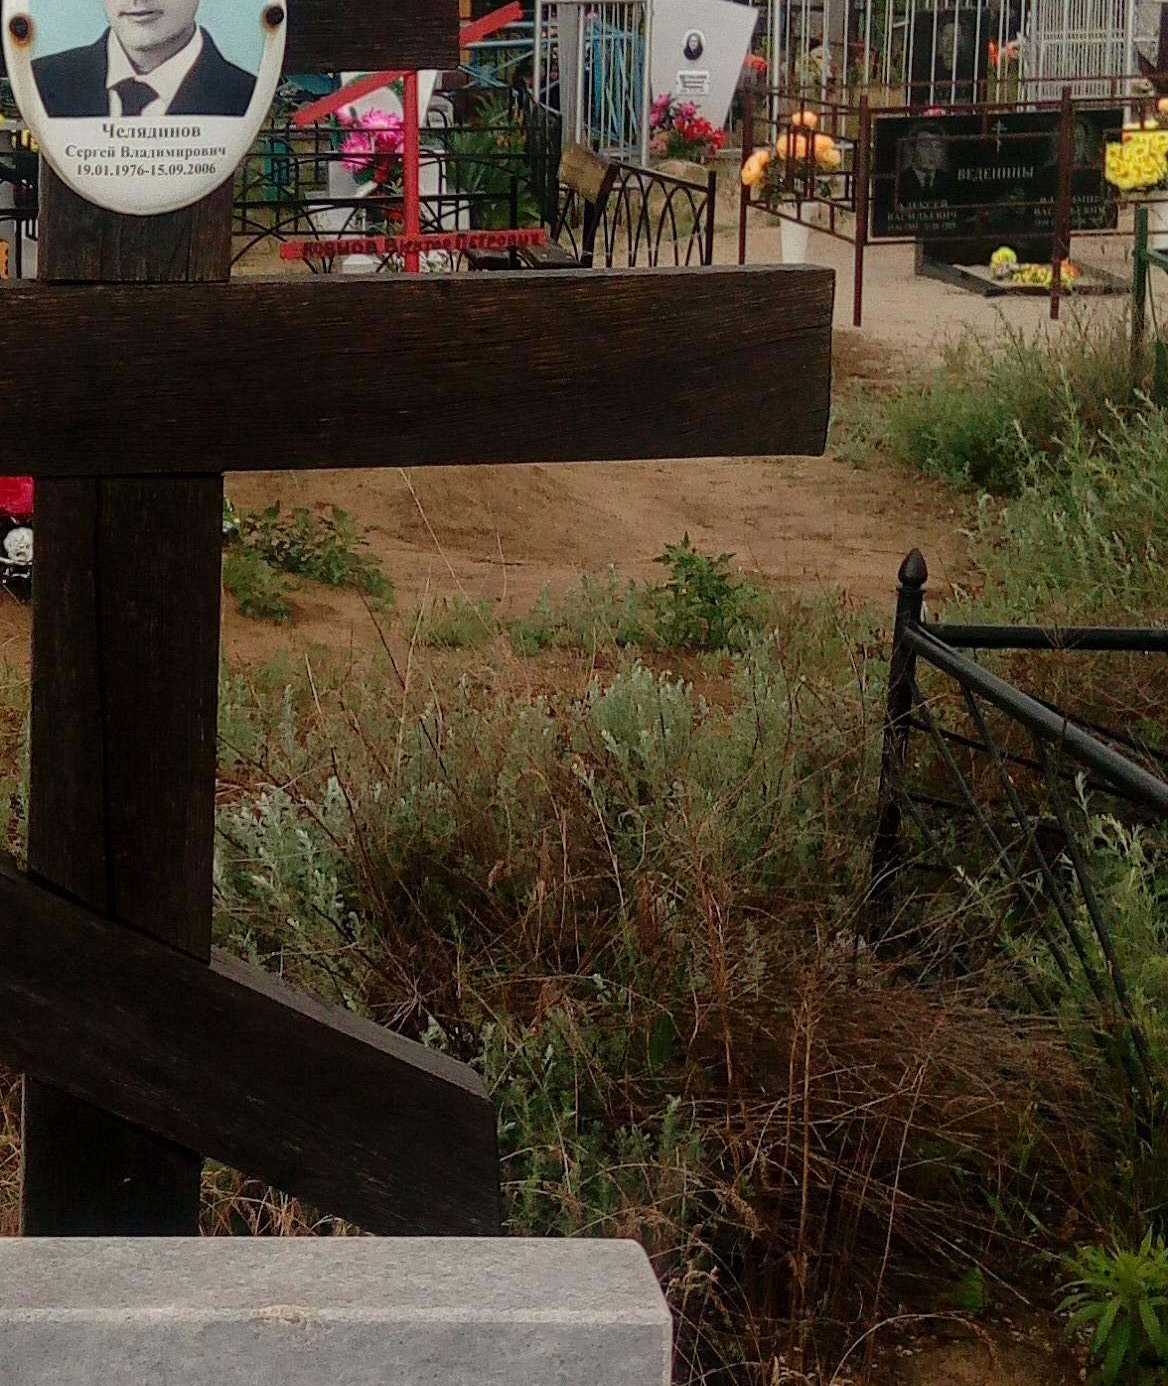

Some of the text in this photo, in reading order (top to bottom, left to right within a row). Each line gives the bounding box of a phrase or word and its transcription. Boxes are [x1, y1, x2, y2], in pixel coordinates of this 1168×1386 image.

[102, 123, 201, 139] Челядинов
[65, 144, 227, 160] Сергей Владимирович
[76, 163, 217, 177] 19.01.1976-15.09.2006
